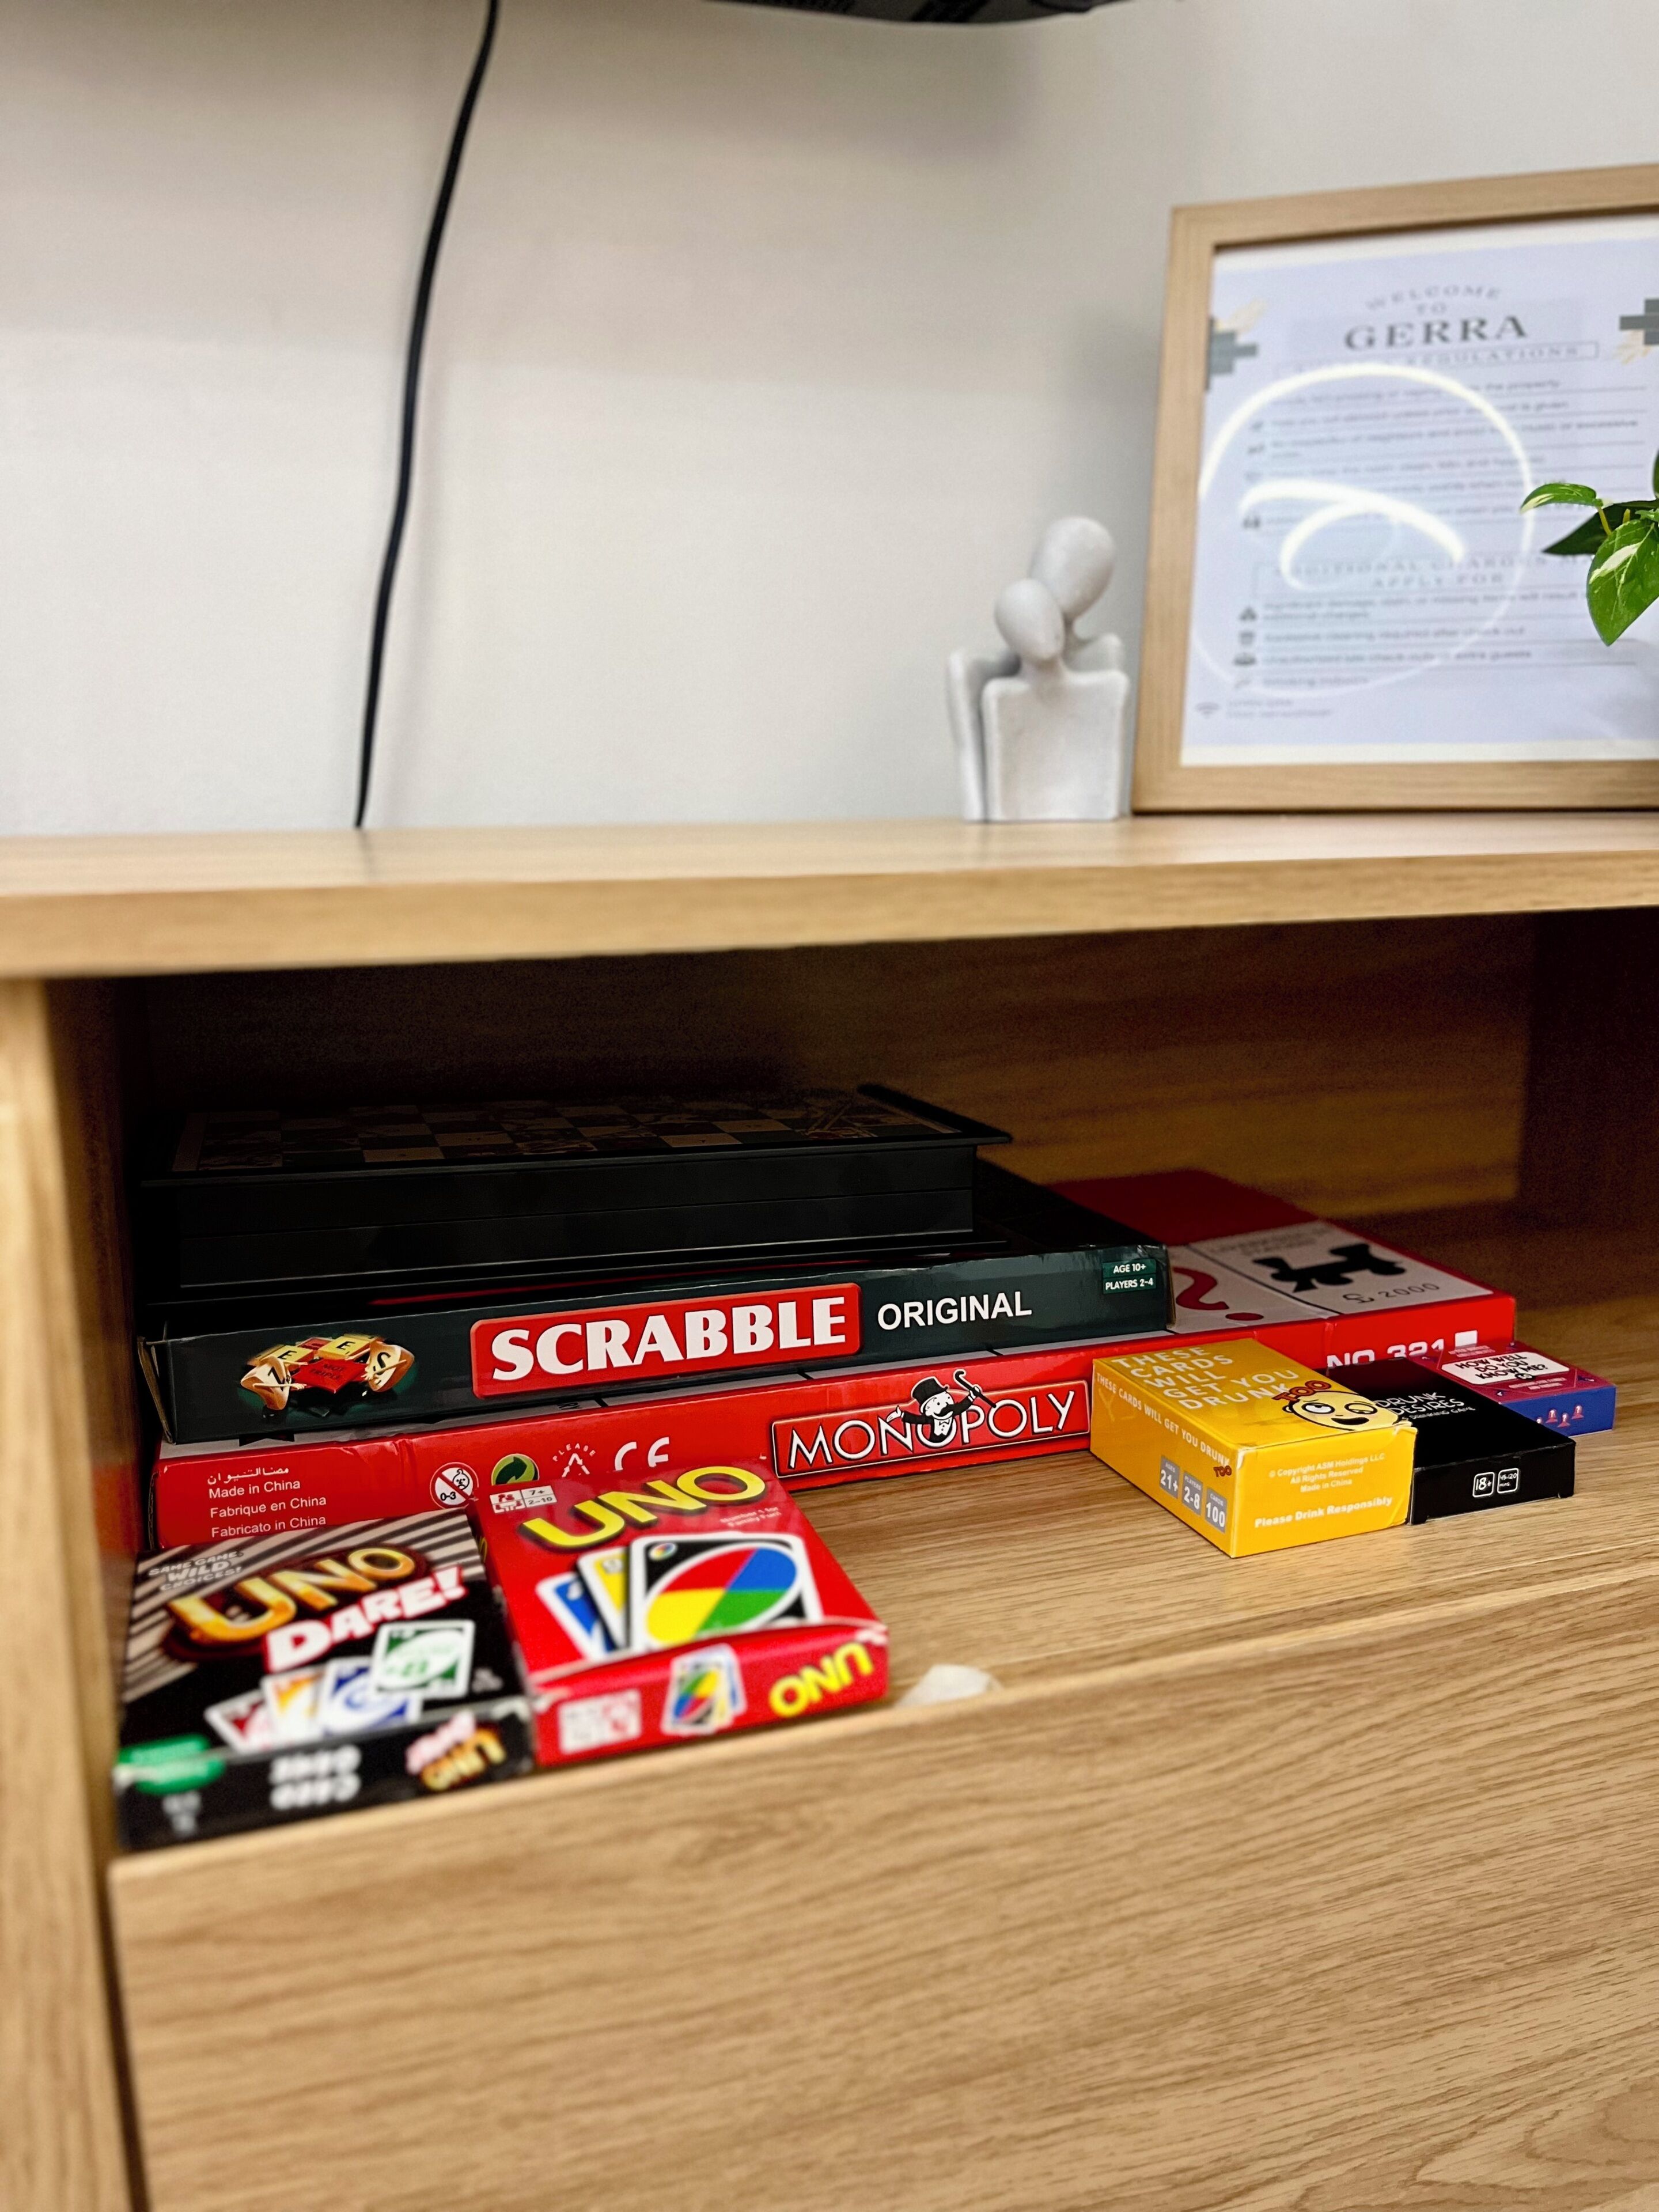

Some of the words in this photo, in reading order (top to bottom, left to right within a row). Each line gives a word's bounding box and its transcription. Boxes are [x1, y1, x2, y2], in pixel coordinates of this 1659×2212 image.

[1366, 285, 1501, 310] WELCOME
[1416, 302, 1447, 315] TO
[1344, 315, 1528, 350] GERRA
[1113, 1264, 1130, 1274] AGE
[1132, 1263, 1146, 1271] 10+
[1105, 1279, 1138, 1290] PLAYERS
[1139, 1278, 1154, 1287] 2-4
[1378, 1283, 1440, 1298] 2000
[878, 1291, 1032, 1331] ORIGINAL
[491, 1296, 846, 1381] SCRABBLE
[1111, 1346, 1210, 1369] THESE
[1130, 1354, 1233, 1378] CARDS
[1455, 1358, 1489, 1369] HOW
[1489, 1354, 1528, 1363] WELL
[1474, 1364, 1498, 1373] DO
[1500, 1360, 1529, 1369] YOU
[1143, 1370, 1226, 1388] WILL
[1475, 1368, 1520, 1380] KNOW
[1520, 1363, 1548, 1373] ME?
[1163, 1382, 1224, 1399] GET
[1232, 1369, 1300, 1388] YOU
[1272, 1380, 1332, 1402] TOO
[1178, 1382, 1290, 1410] DRUNK
[1374, 1392, 1446, 1408] DRUNK
[1387, 1398, 1465, 1416] DESIRES
[788, 1390, 1075, 1469] MONOPOLY
[1096, 1373, 1117, 1395] THESE
[1119, 1388, 1142, 1411] CARDS
[1144, 1403, 1162, 1425] WILL
[1164, 1418, 1179, 1435] GET
[1181, 1428, 1198, 1448] YOU
[1200, 1441, 1230, 1467] DRUNK
[552, 1442, 597, 1462] PLEASE
[1370, 1453, 1385, 1461] LLC
[1160, 1469, 1179, 1492] 21+
[1213, 1465, 1232, 1478] TOO
[1302, 1472, 1327, 1483] Rights
[1328, 1466, 1363, 1478] Reserved
[209, 1486, 245, 1499] Made
[249, 1484, 260, 1494] in
[264, 1480, 301, 1493] China
[1300, 1484, 1321, 1493] Made
[1331, 1479, 1353, 1487] China
[1475, 1476, 1492, 1491] 18+
[210, 1503, 267, 1518] Fabrique
[270, 1502, 286, 1512] en
[290, 1497, 327, 1509] China
[521, 1465, 767, 1548] UNO
[1183, 1486, 1200, 1510] 2-8
[1206, 1502, 1226, 1528] 100
[1255, 1515, 1293, 1528] Please
[1295, 1508, 1325, 1521] Drink
[1327, 1496, 1393, 1513] Responsibly
[211, 1522, 271, 1538] Fabricato
[275, 1520, 286, 1531] in
[290, 1516, 326, 1529] China
[149, 1561, 191, 1576] SAME
[168, 1560, 230, 1582] WILD
[168, 1546, 416, 1643] UNO
[267, 1569, 464, 1670] DARE!
[768, 1641, 874, 1718] UNO
